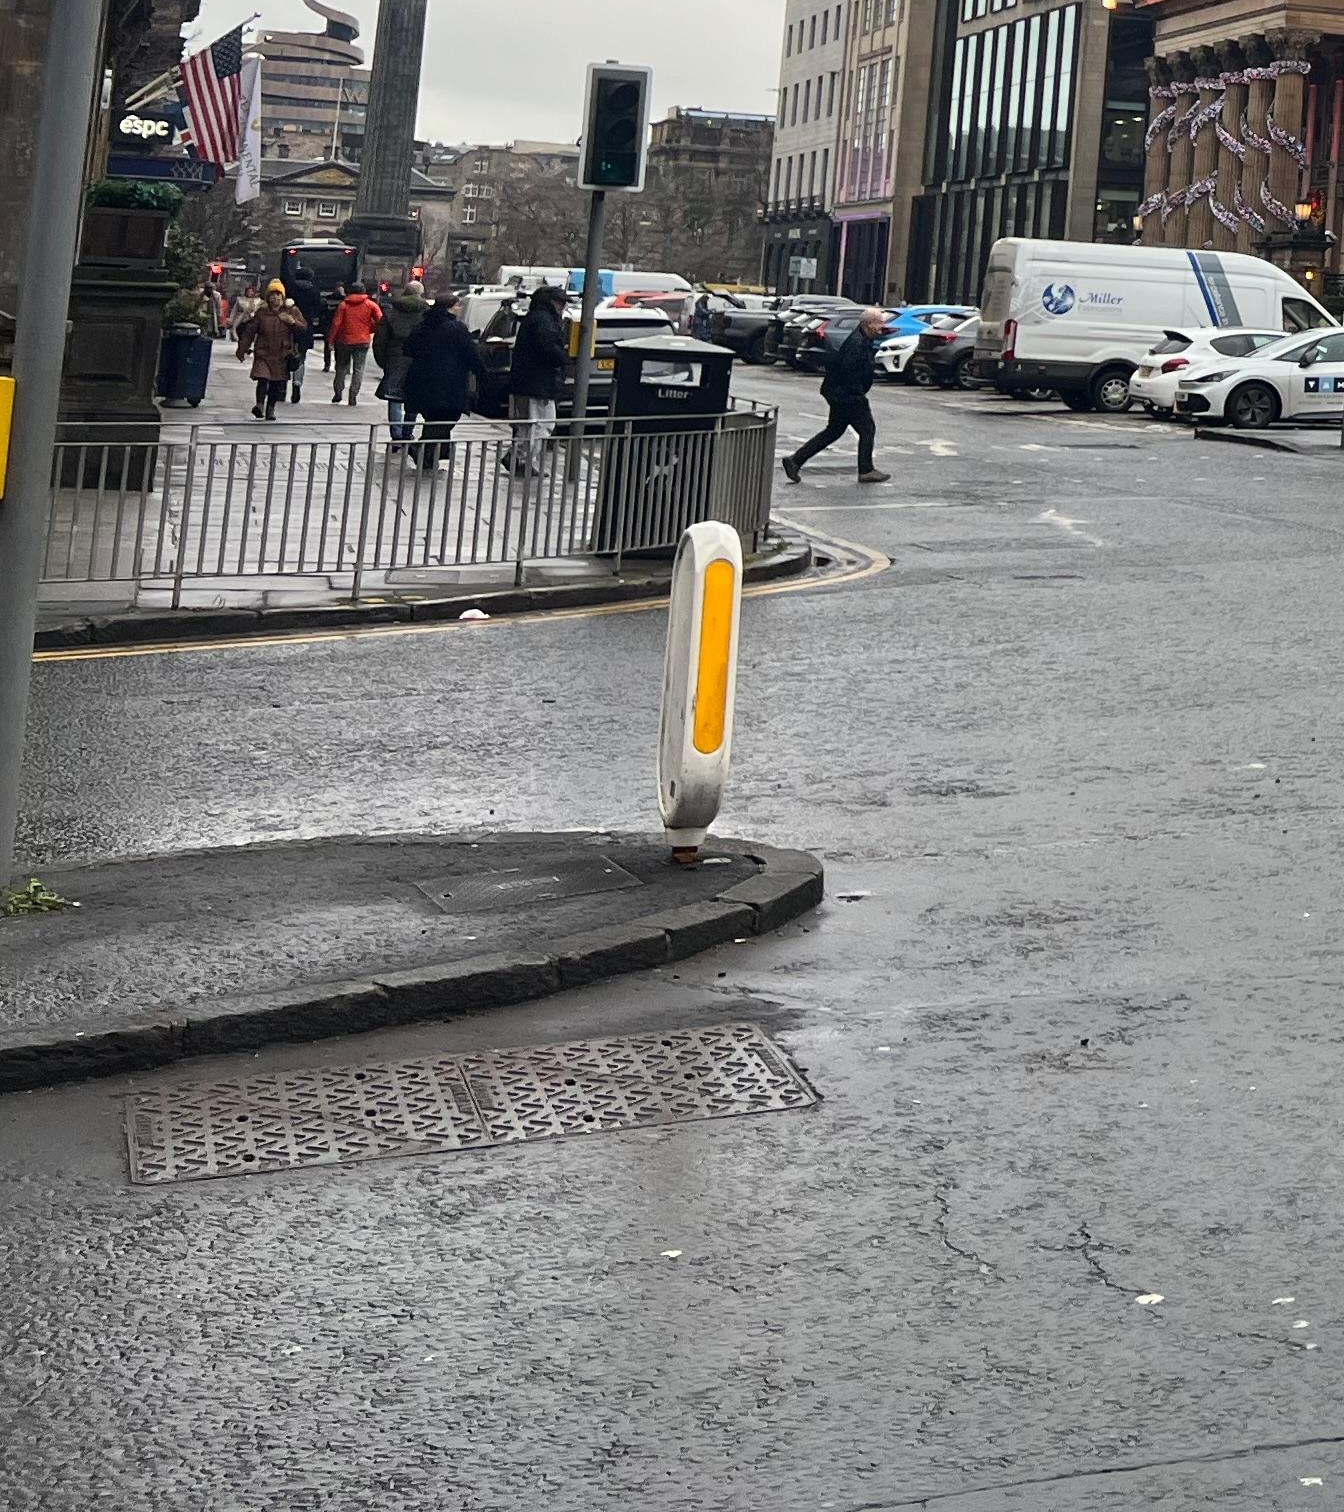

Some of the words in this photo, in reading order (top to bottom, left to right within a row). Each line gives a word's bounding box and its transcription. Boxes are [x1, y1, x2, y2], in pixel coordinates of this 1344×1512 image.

[119, 114, 169, 139] espc
[1079, 292, 1123, 305] Miller
[657, 388, 689, 399] Litter
